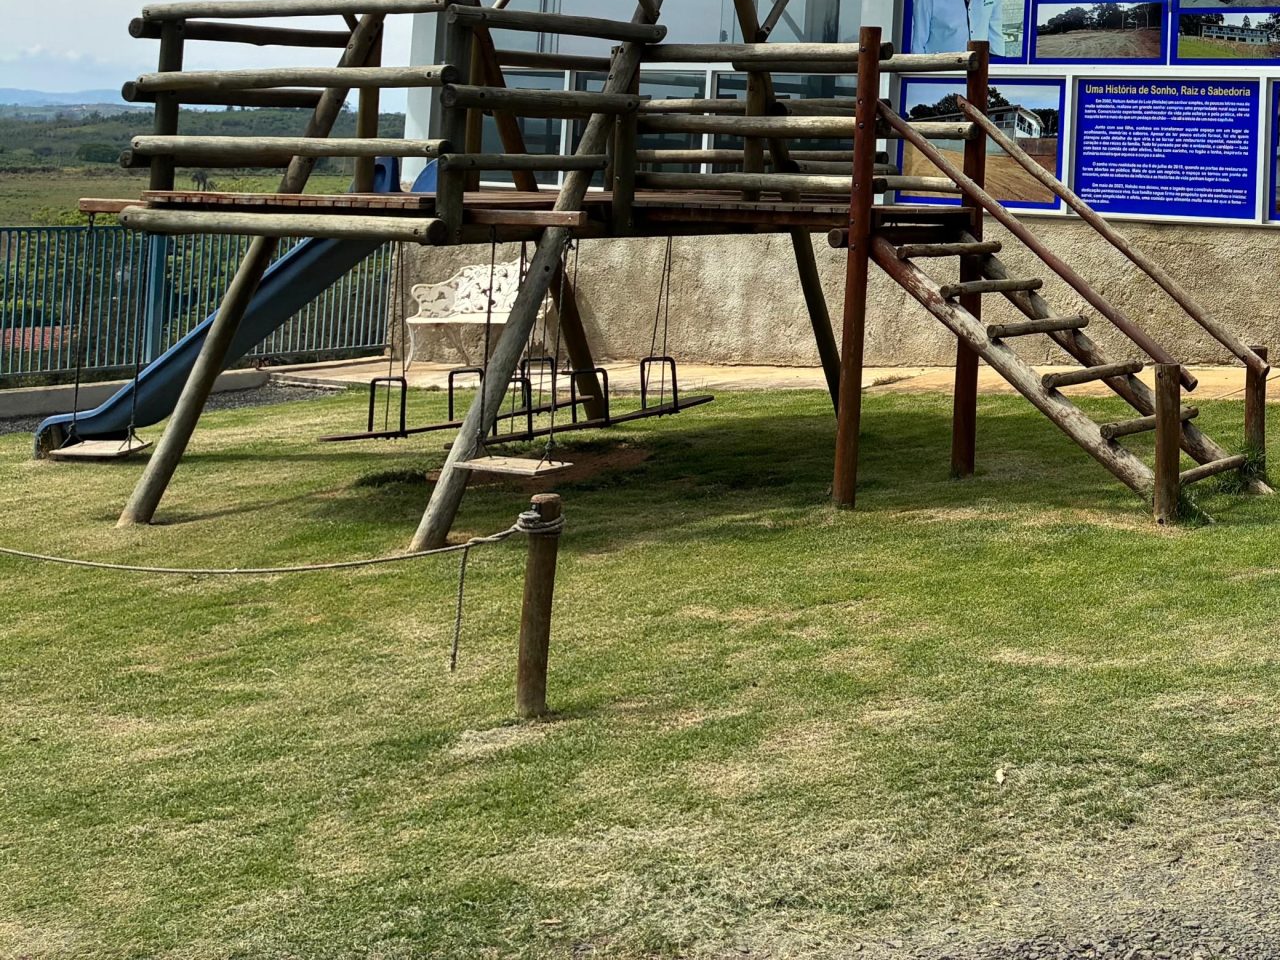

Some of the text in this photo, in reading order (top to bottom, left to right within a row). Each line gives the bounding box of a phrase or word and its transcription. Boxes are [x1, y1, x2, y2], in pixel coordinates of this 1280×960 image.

[1085, 84, 1104, 94] Uma
[1105, 85, 1136, 94] História
[1138, 86, 1149, 94] de
[1150, 85, 1179, 96] Sonho,
[1180, 85, 1199, 96] Raiz
[1207, 86, 1251, 97] Sabedoria
